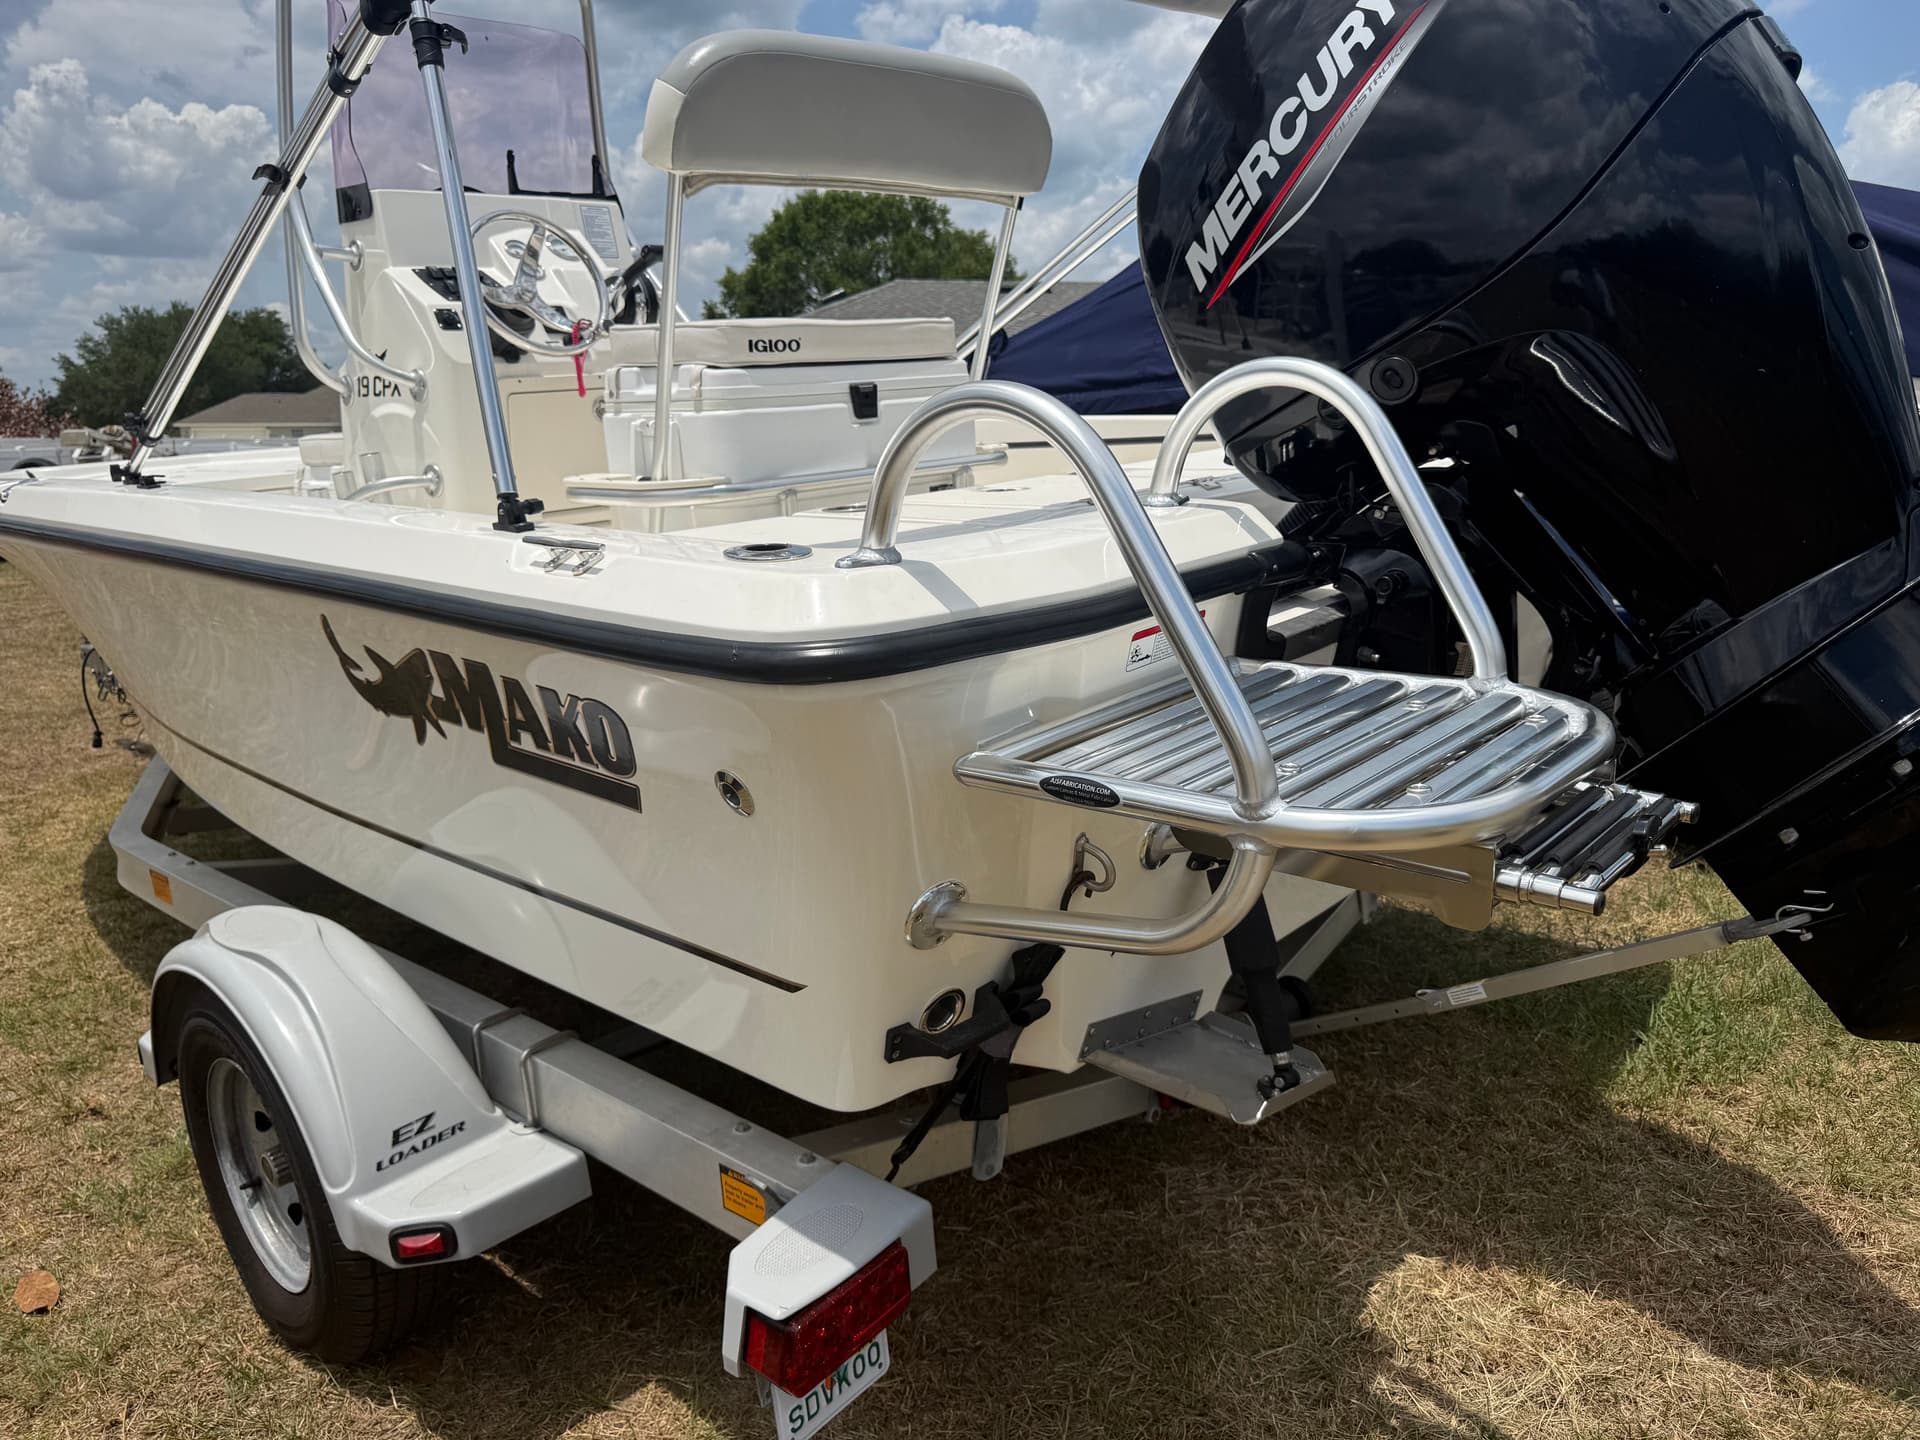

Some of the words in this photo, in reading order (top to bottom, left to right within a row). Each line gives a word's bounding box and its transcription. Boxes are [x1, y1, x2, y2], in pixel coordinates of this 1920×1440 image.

[748, 338, 801, 353] IGLOO
[357, 375, 370, 398] 19
[426, 649, 642, 813] MAKO
[375, 1120, 466, 1173] LOADER
[391, 1111, 436, 1148] EZ
